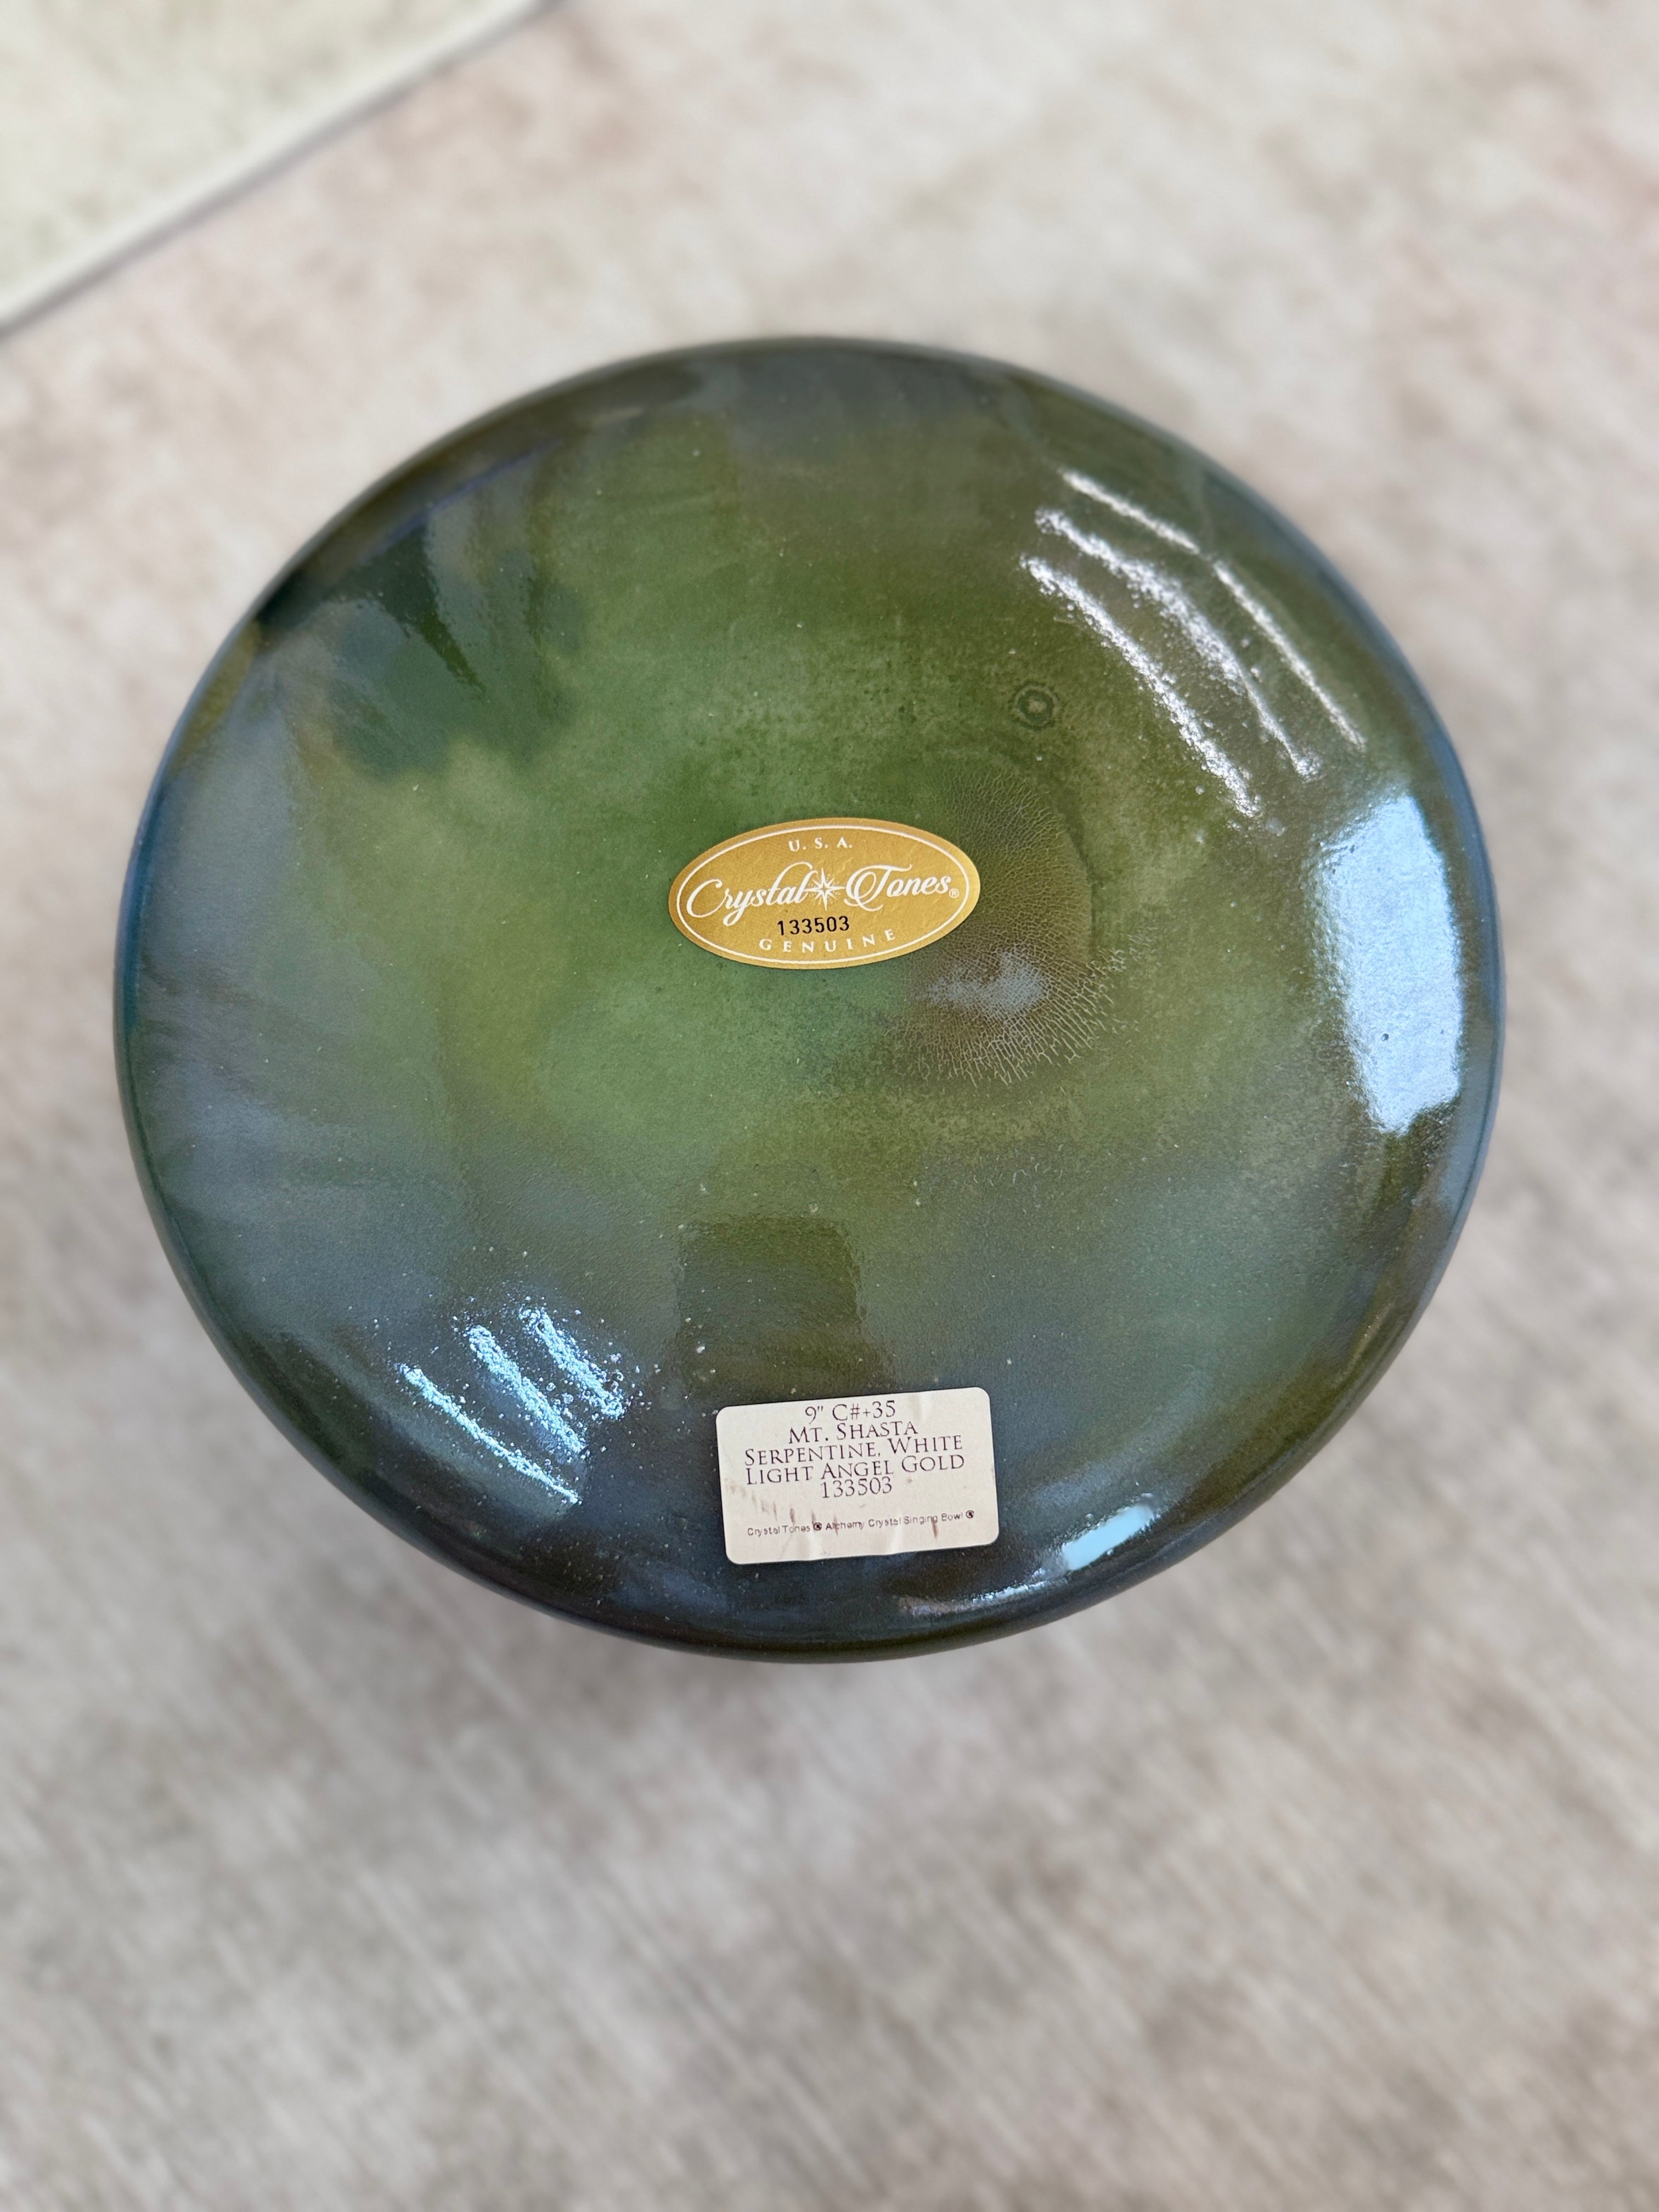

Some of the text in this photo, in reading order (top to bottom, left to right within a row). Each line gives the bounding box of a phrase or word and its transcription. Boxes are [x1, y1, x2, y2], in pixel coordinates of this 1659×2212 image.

[686, 861, 818, 926] Crystal
[777, 916, 850, 936] 133503
[759, 929, 895, 953] GENUINE
[805, 1400, 896, 1425] 9" C#+35
[837, 1420, 918, 1440] SHASTA
[888, 1435, 963, 1455] WHITE
[746, 1454, 965, 1486] LIGHT ANGEL GOLD
[821, 1476, 893, 1499] 133503
[747, 1526, 780, 1537] Crystal
[782, 1524, 811, 1534] Tones
[825, 1521, 865, 1531] Alchemy
[868, 1517, 901, 1528] Crystal
[904, 1515, 938, 1525] Singing
[941, 1511, 963, 1521] Bowl
